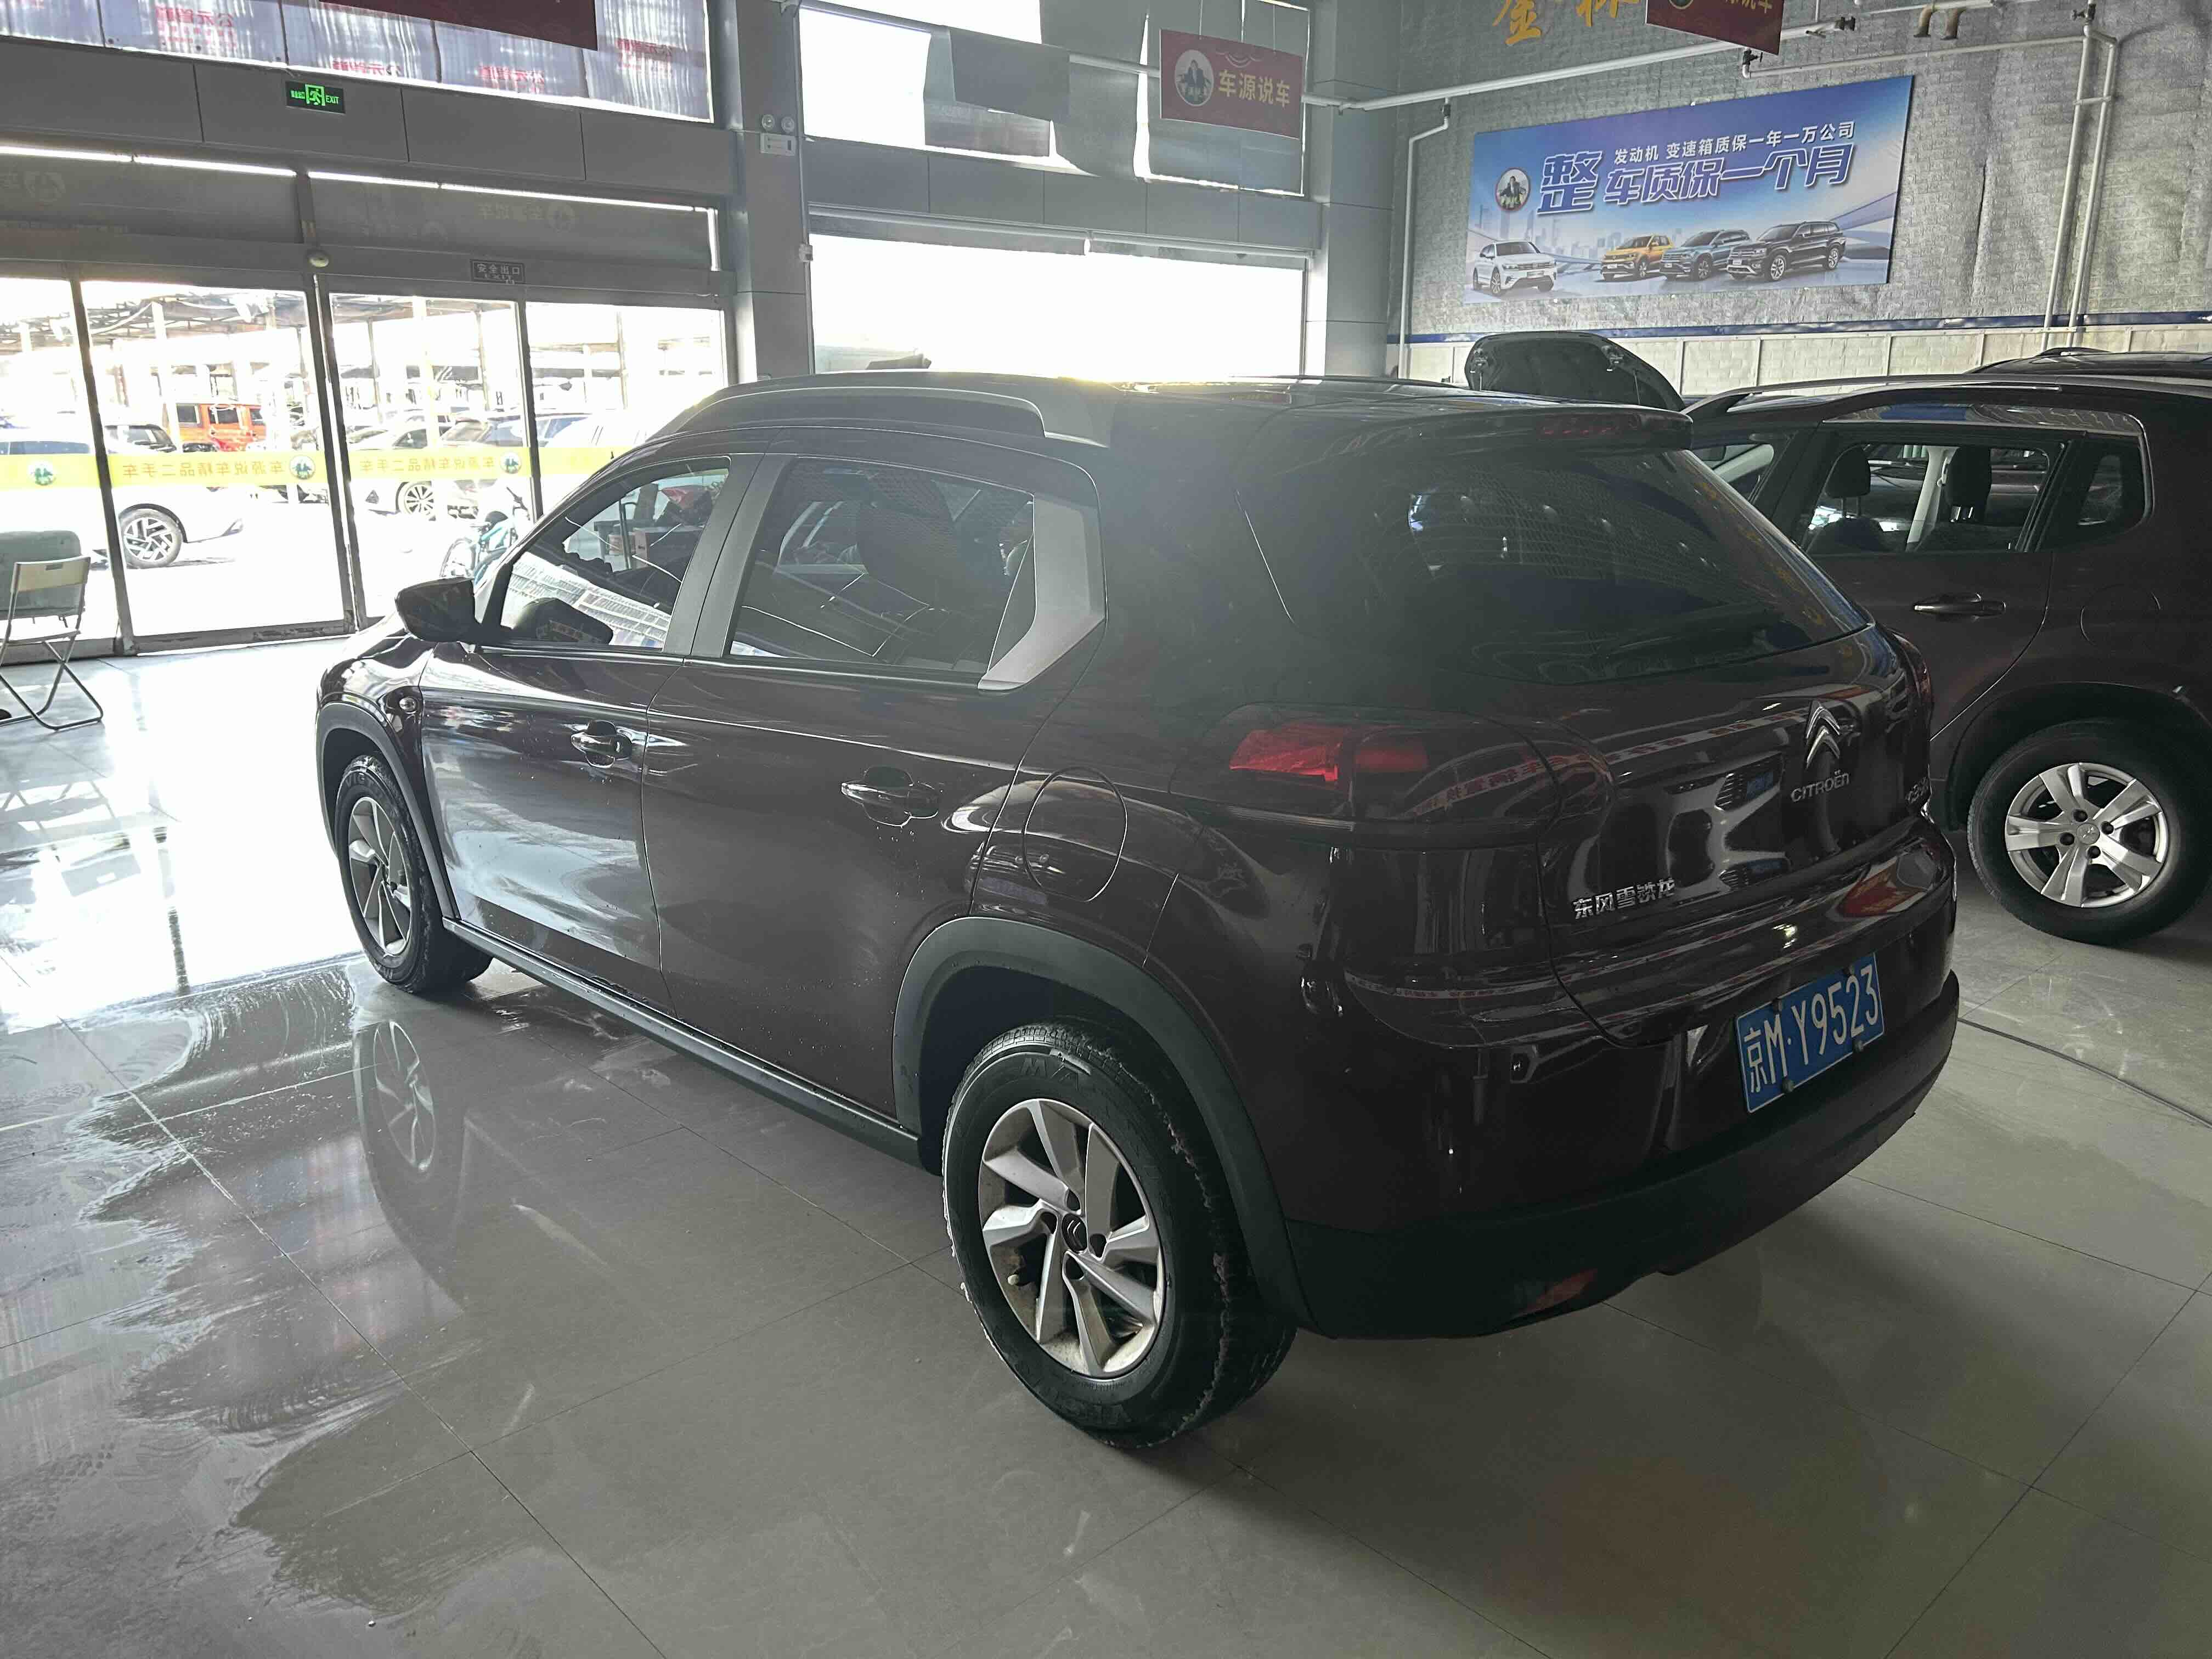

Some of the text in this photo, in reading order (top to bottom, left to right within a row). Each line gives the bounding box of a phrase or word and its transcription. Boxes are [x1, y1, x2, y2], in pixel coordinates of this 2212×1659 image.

[325, 95, 340, 104] EXIT
[1218, 69, 1291, 110] 车源说车
[1615, 120, 1855, 164] 发动机 变速箱质保一年一万公司
[1537, 143, 1854, 215] 整车质保一个月
[477, 263, 519, 274] 安全出口
[1573, 878, 1675, 919] 东风雪铁龙
